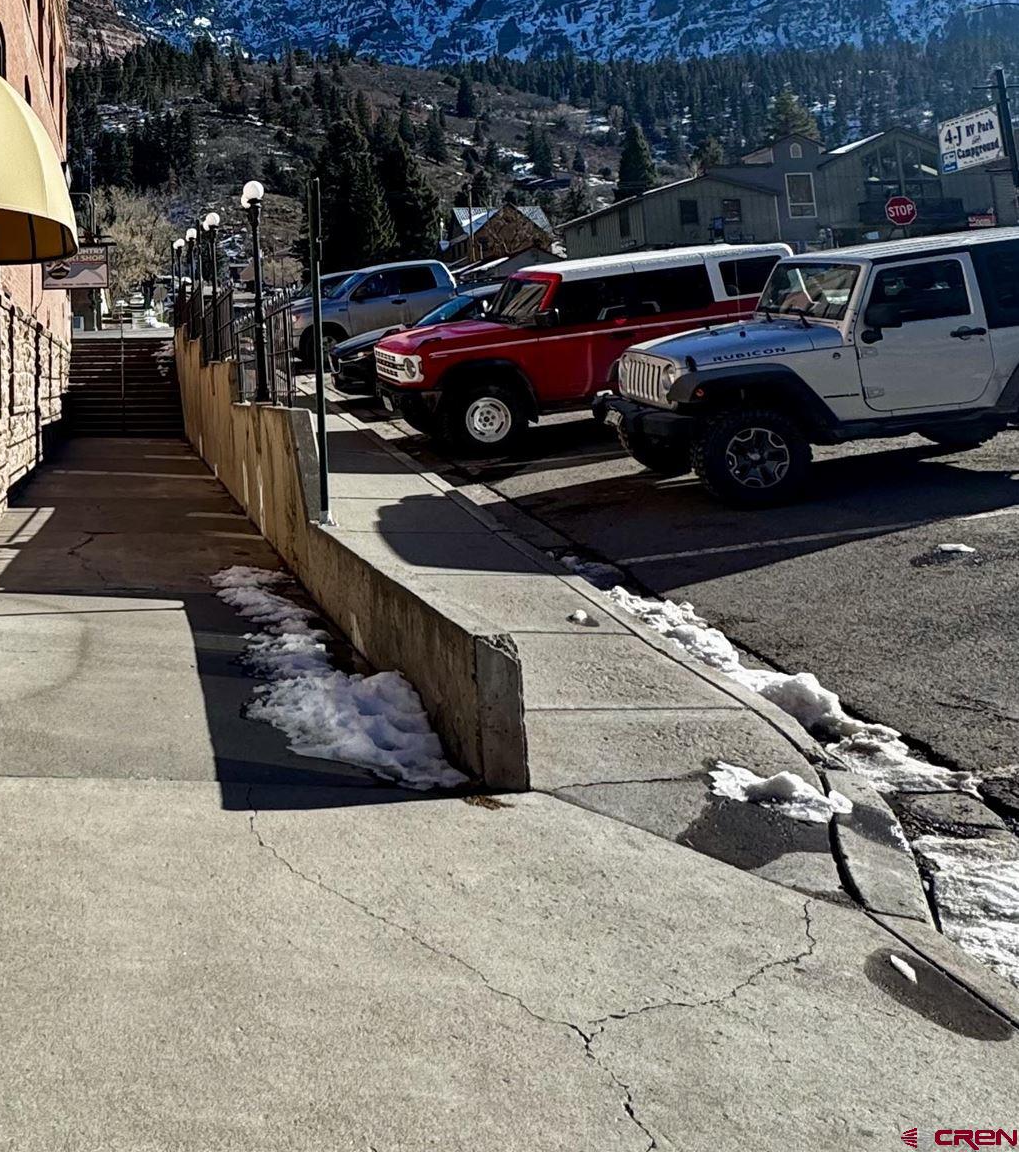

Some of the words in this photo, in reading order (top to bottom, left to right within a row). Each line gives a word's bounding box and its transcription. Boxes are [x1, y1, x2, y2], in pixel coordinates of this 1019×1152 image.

[944, 126, 962, 146] 4-J
[965, 123, 975, 137] RV
[977, 119, 994, 132] Park
[956, 137, 1000, 159] Campground
[888, 204, 913, 217] STOP
[713, 347, 786, 361] RUBICON
